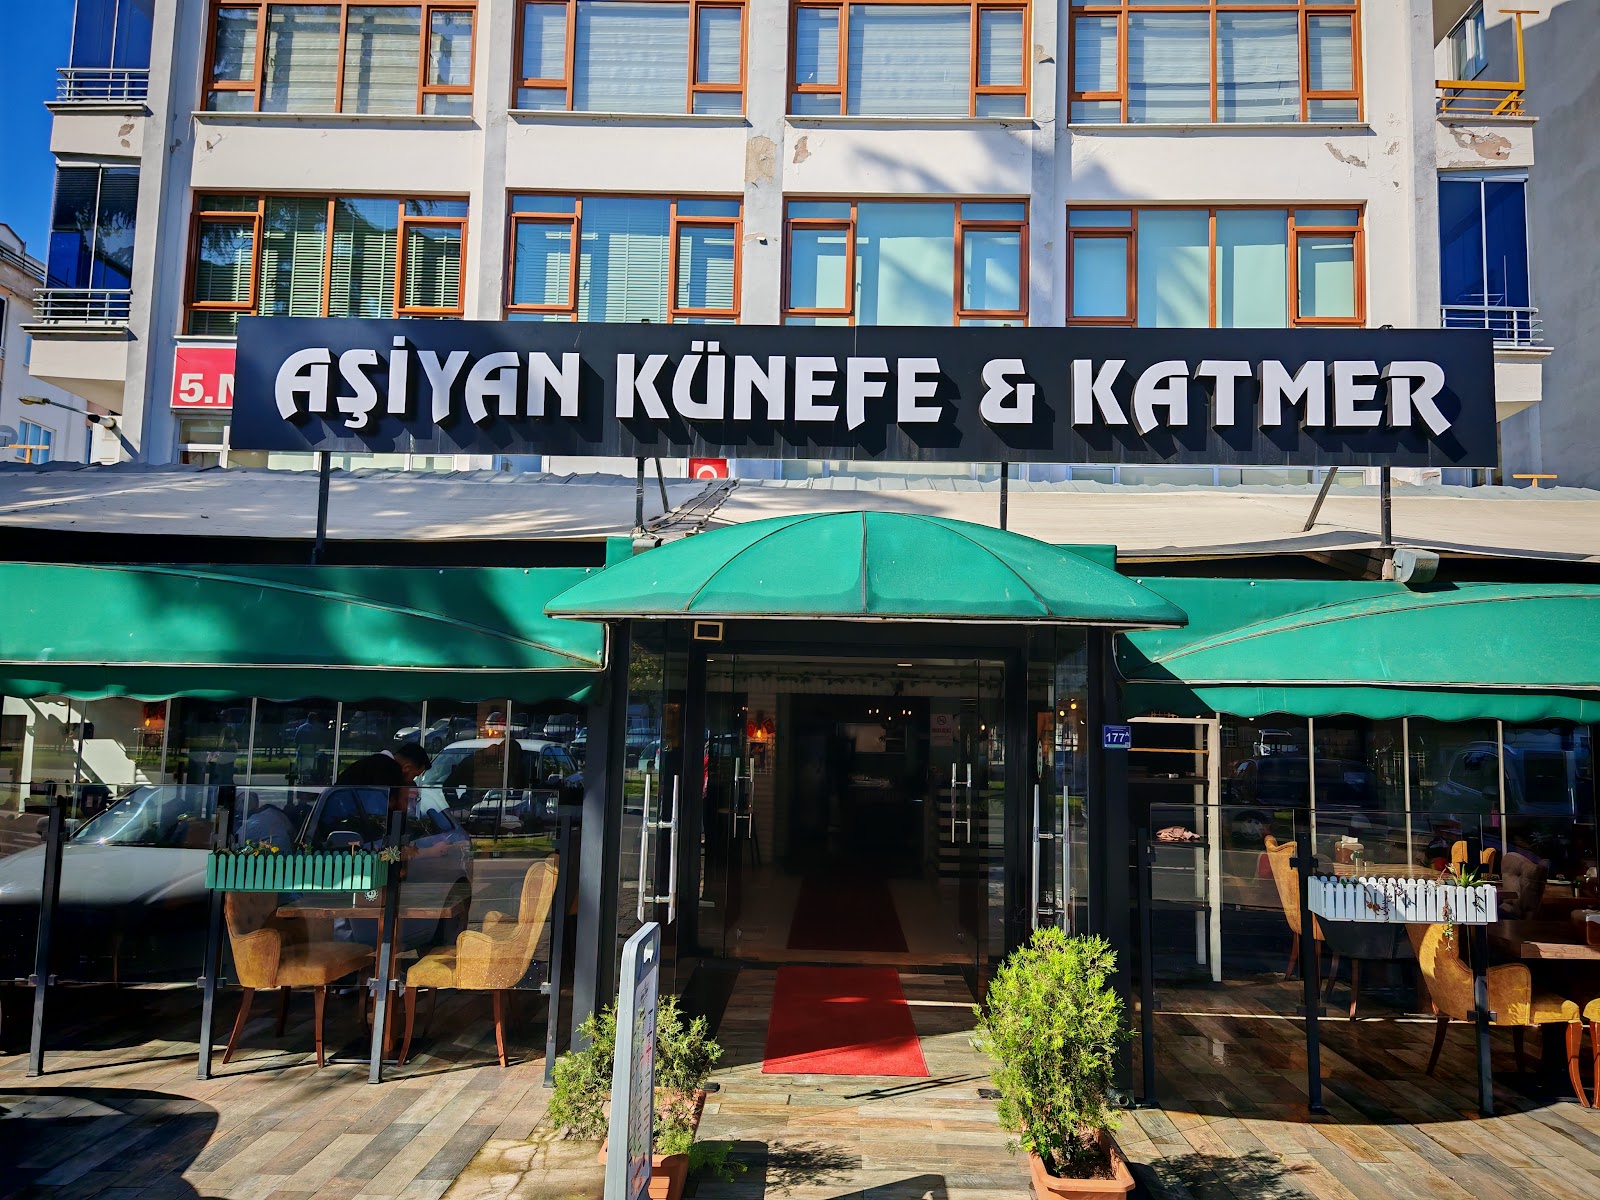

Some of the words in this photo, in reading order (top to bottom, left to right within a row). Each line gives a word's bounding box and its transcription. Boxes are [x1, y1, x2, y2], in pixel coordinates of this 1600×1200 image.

[275, 336, 581, 429] AŞİYAN
[615, 340, 943, 430] KÜNEFE
[980, 358, 1036, 425] &
[1072, 359, 1452, 436] KATMER
